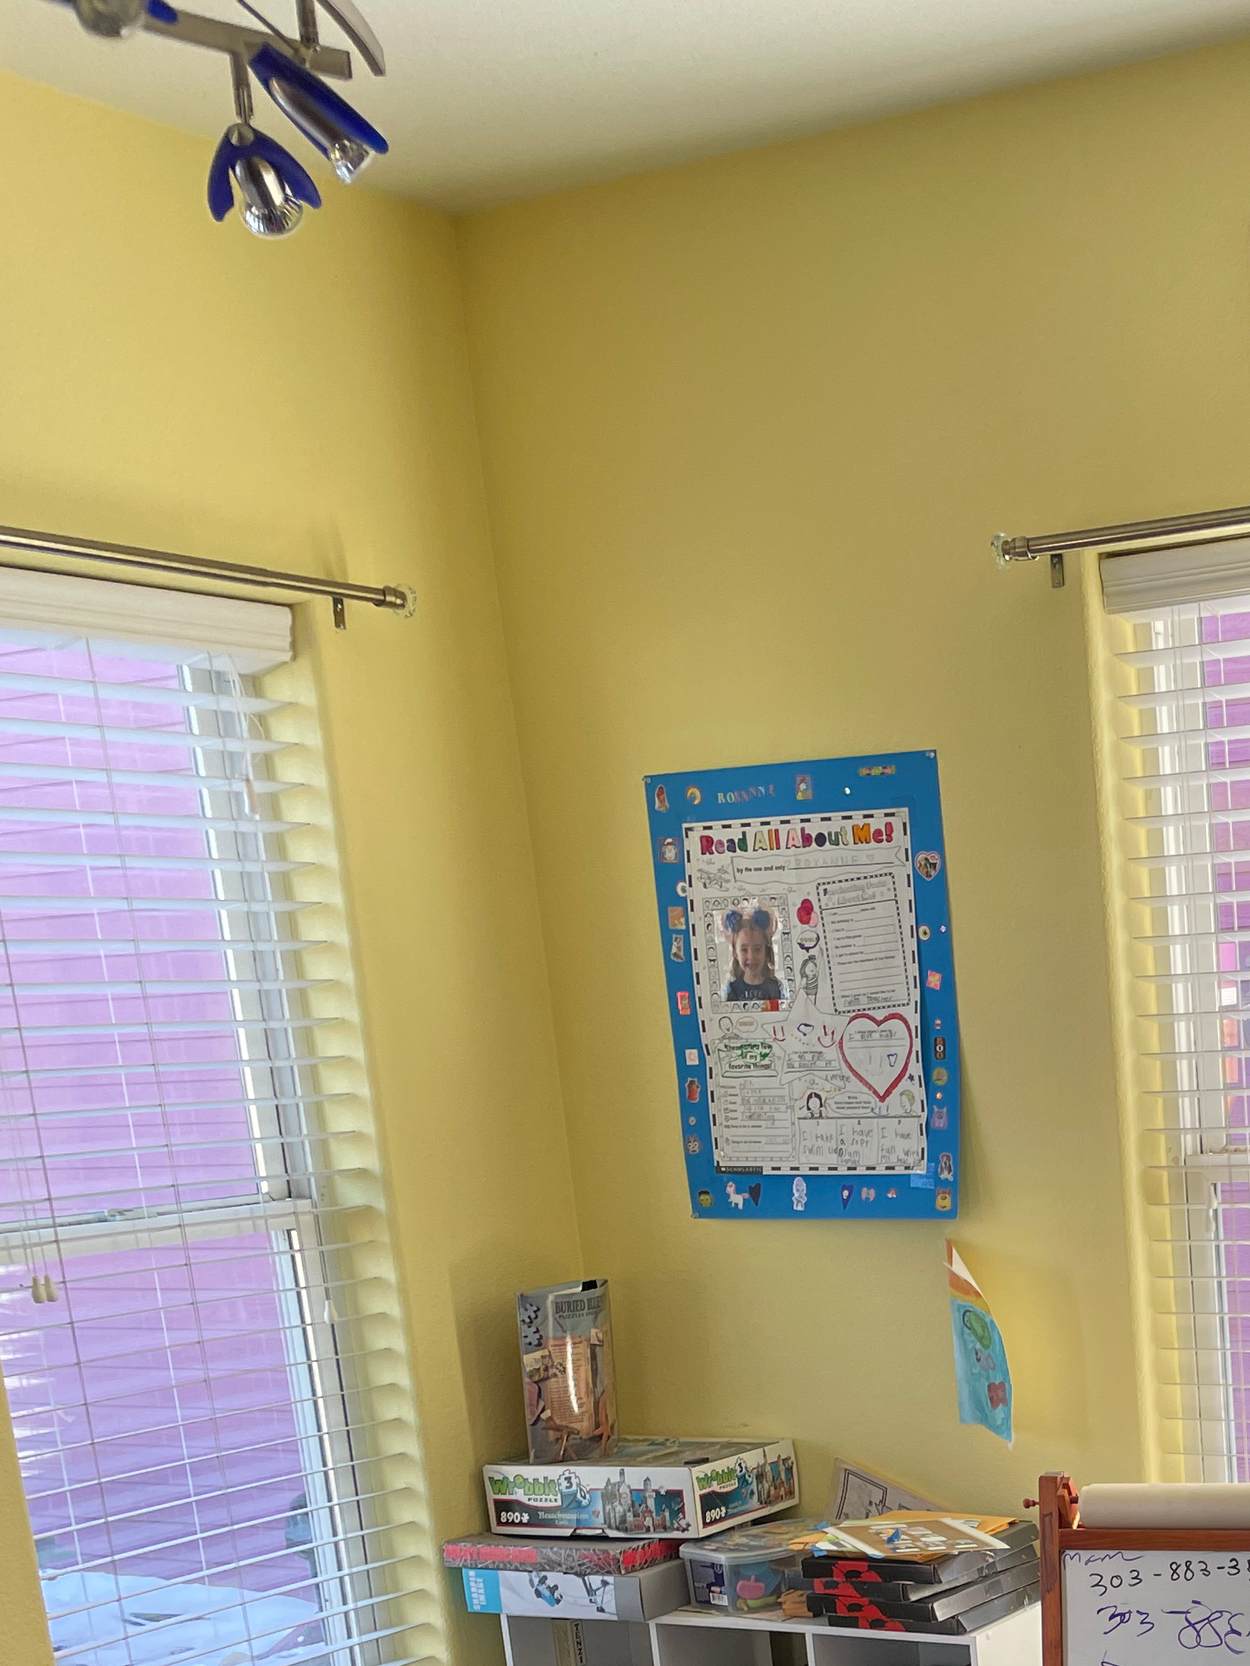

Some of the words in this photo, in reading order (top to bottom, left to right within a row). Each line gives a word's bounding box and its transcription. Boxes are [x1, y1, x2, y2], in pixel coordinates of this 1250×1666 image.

[700, 831, 748, 855] Read
[753, 828, 781, 852] All
[786, 826, 849, 849] About
[852, 822, 894, 846] Me!
[555, 1300, 586, 1314] BURIED
[489, 1474, 558, 1497] Wrebbit
[696, 1467, 737, 1490] Wrebbit
[500, 1511, 520, 1523] 890
[705, 1509, 721, 1522] 890
[574, 1623, 583, 1664] TENZI
